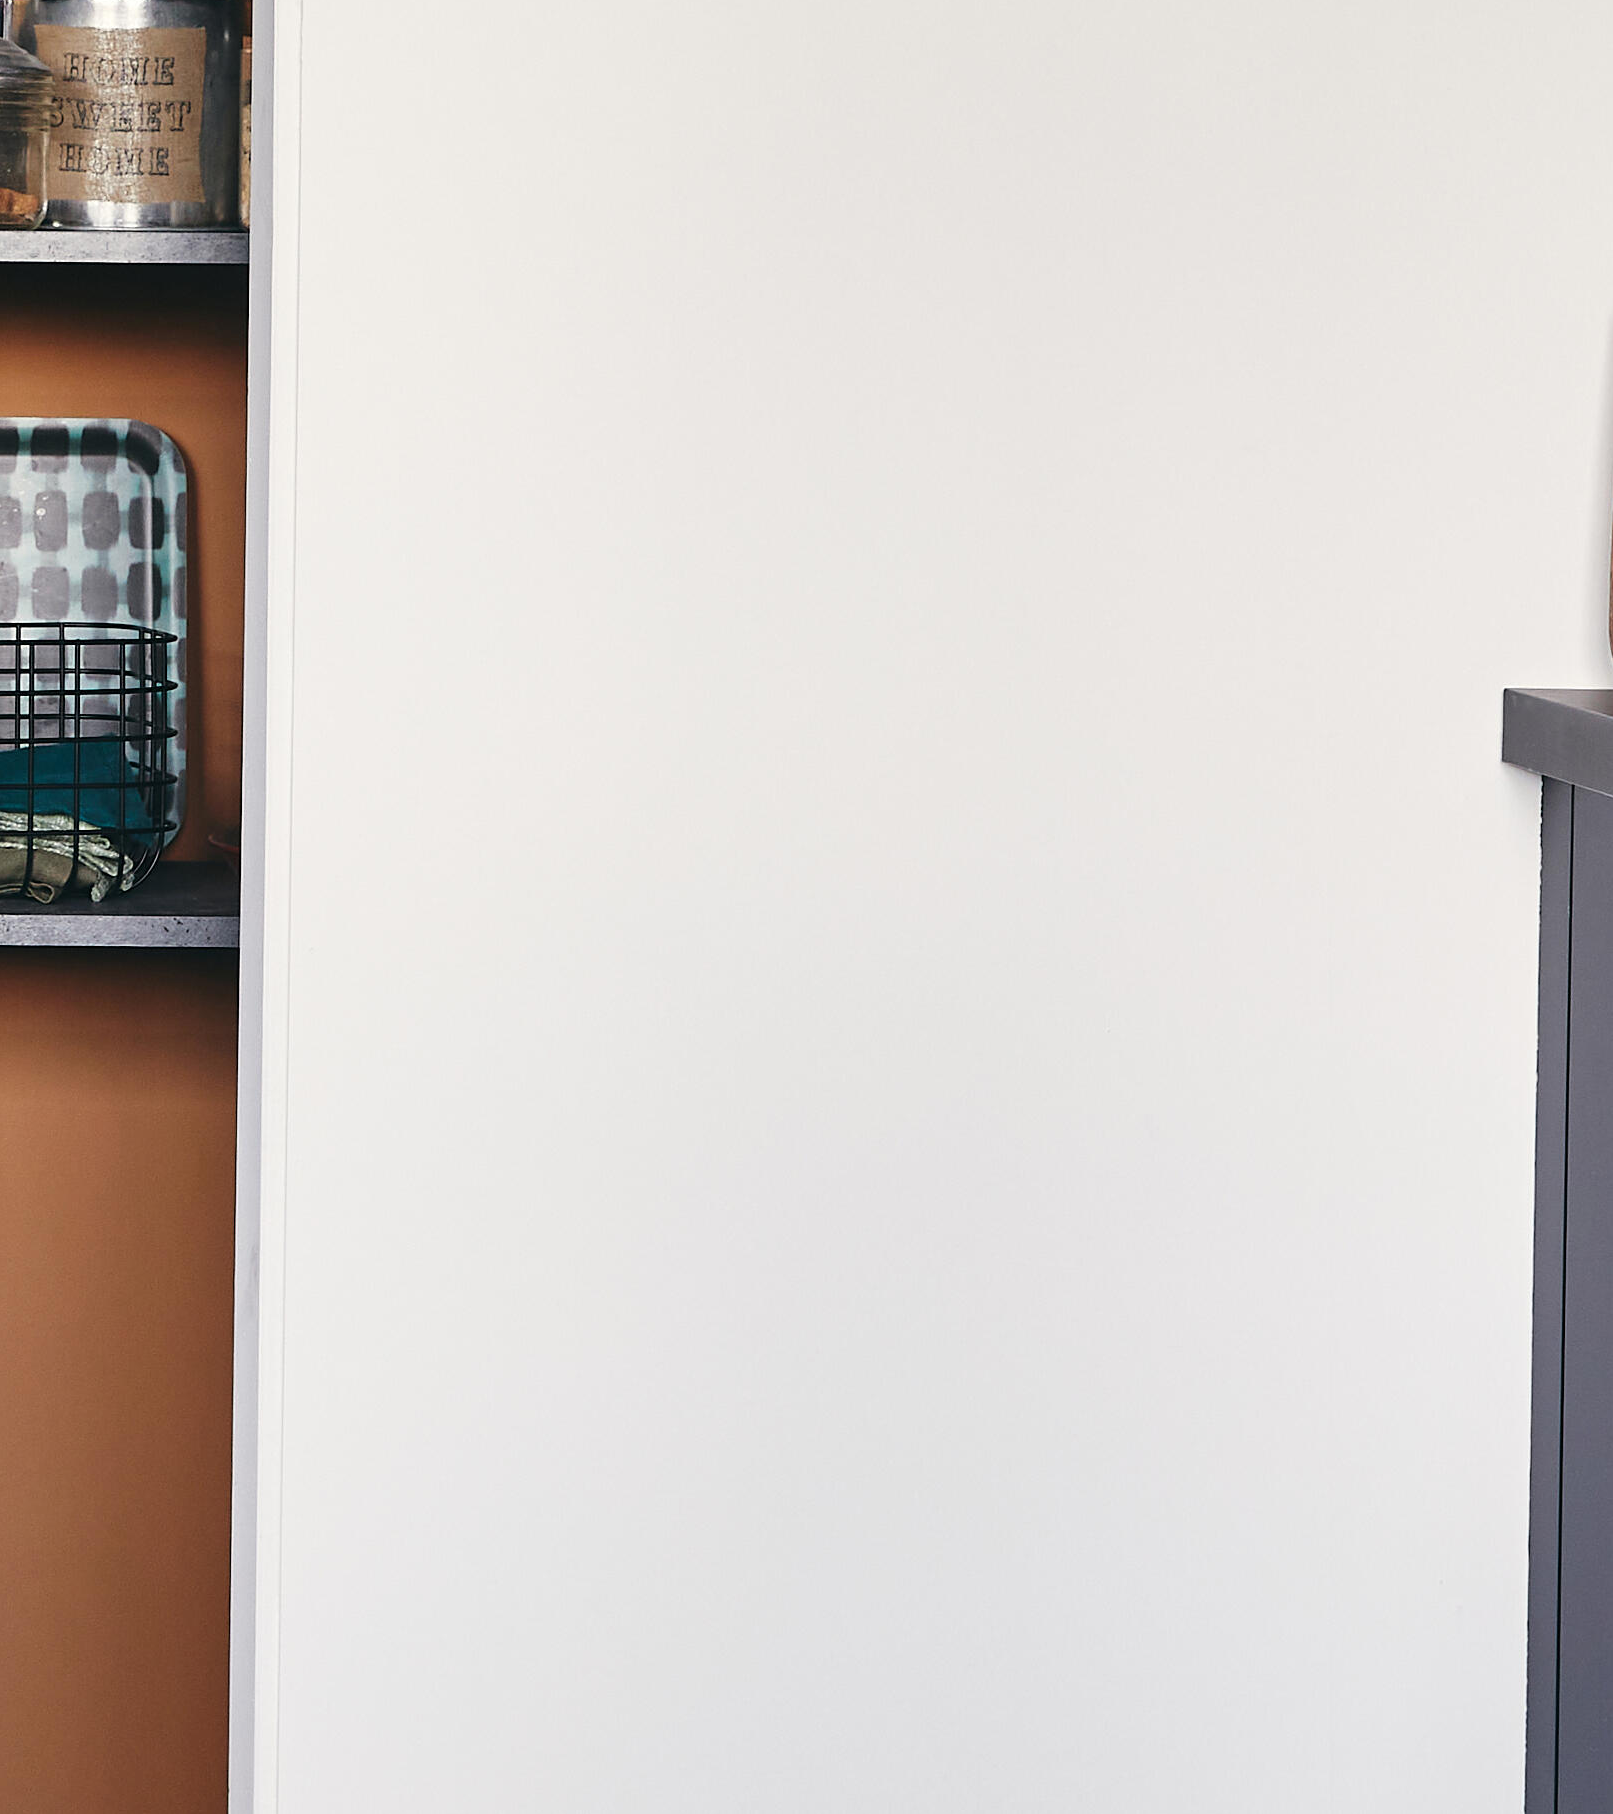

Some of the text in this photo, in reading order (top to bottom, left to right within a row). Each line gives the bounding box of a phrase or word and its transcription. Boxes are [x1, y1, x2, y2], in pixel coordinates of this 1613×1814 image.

[62, 52, 175, 86] HOME
[48, 96, 192, 132] SWEET
[59, 142, 170, 176] HOME
